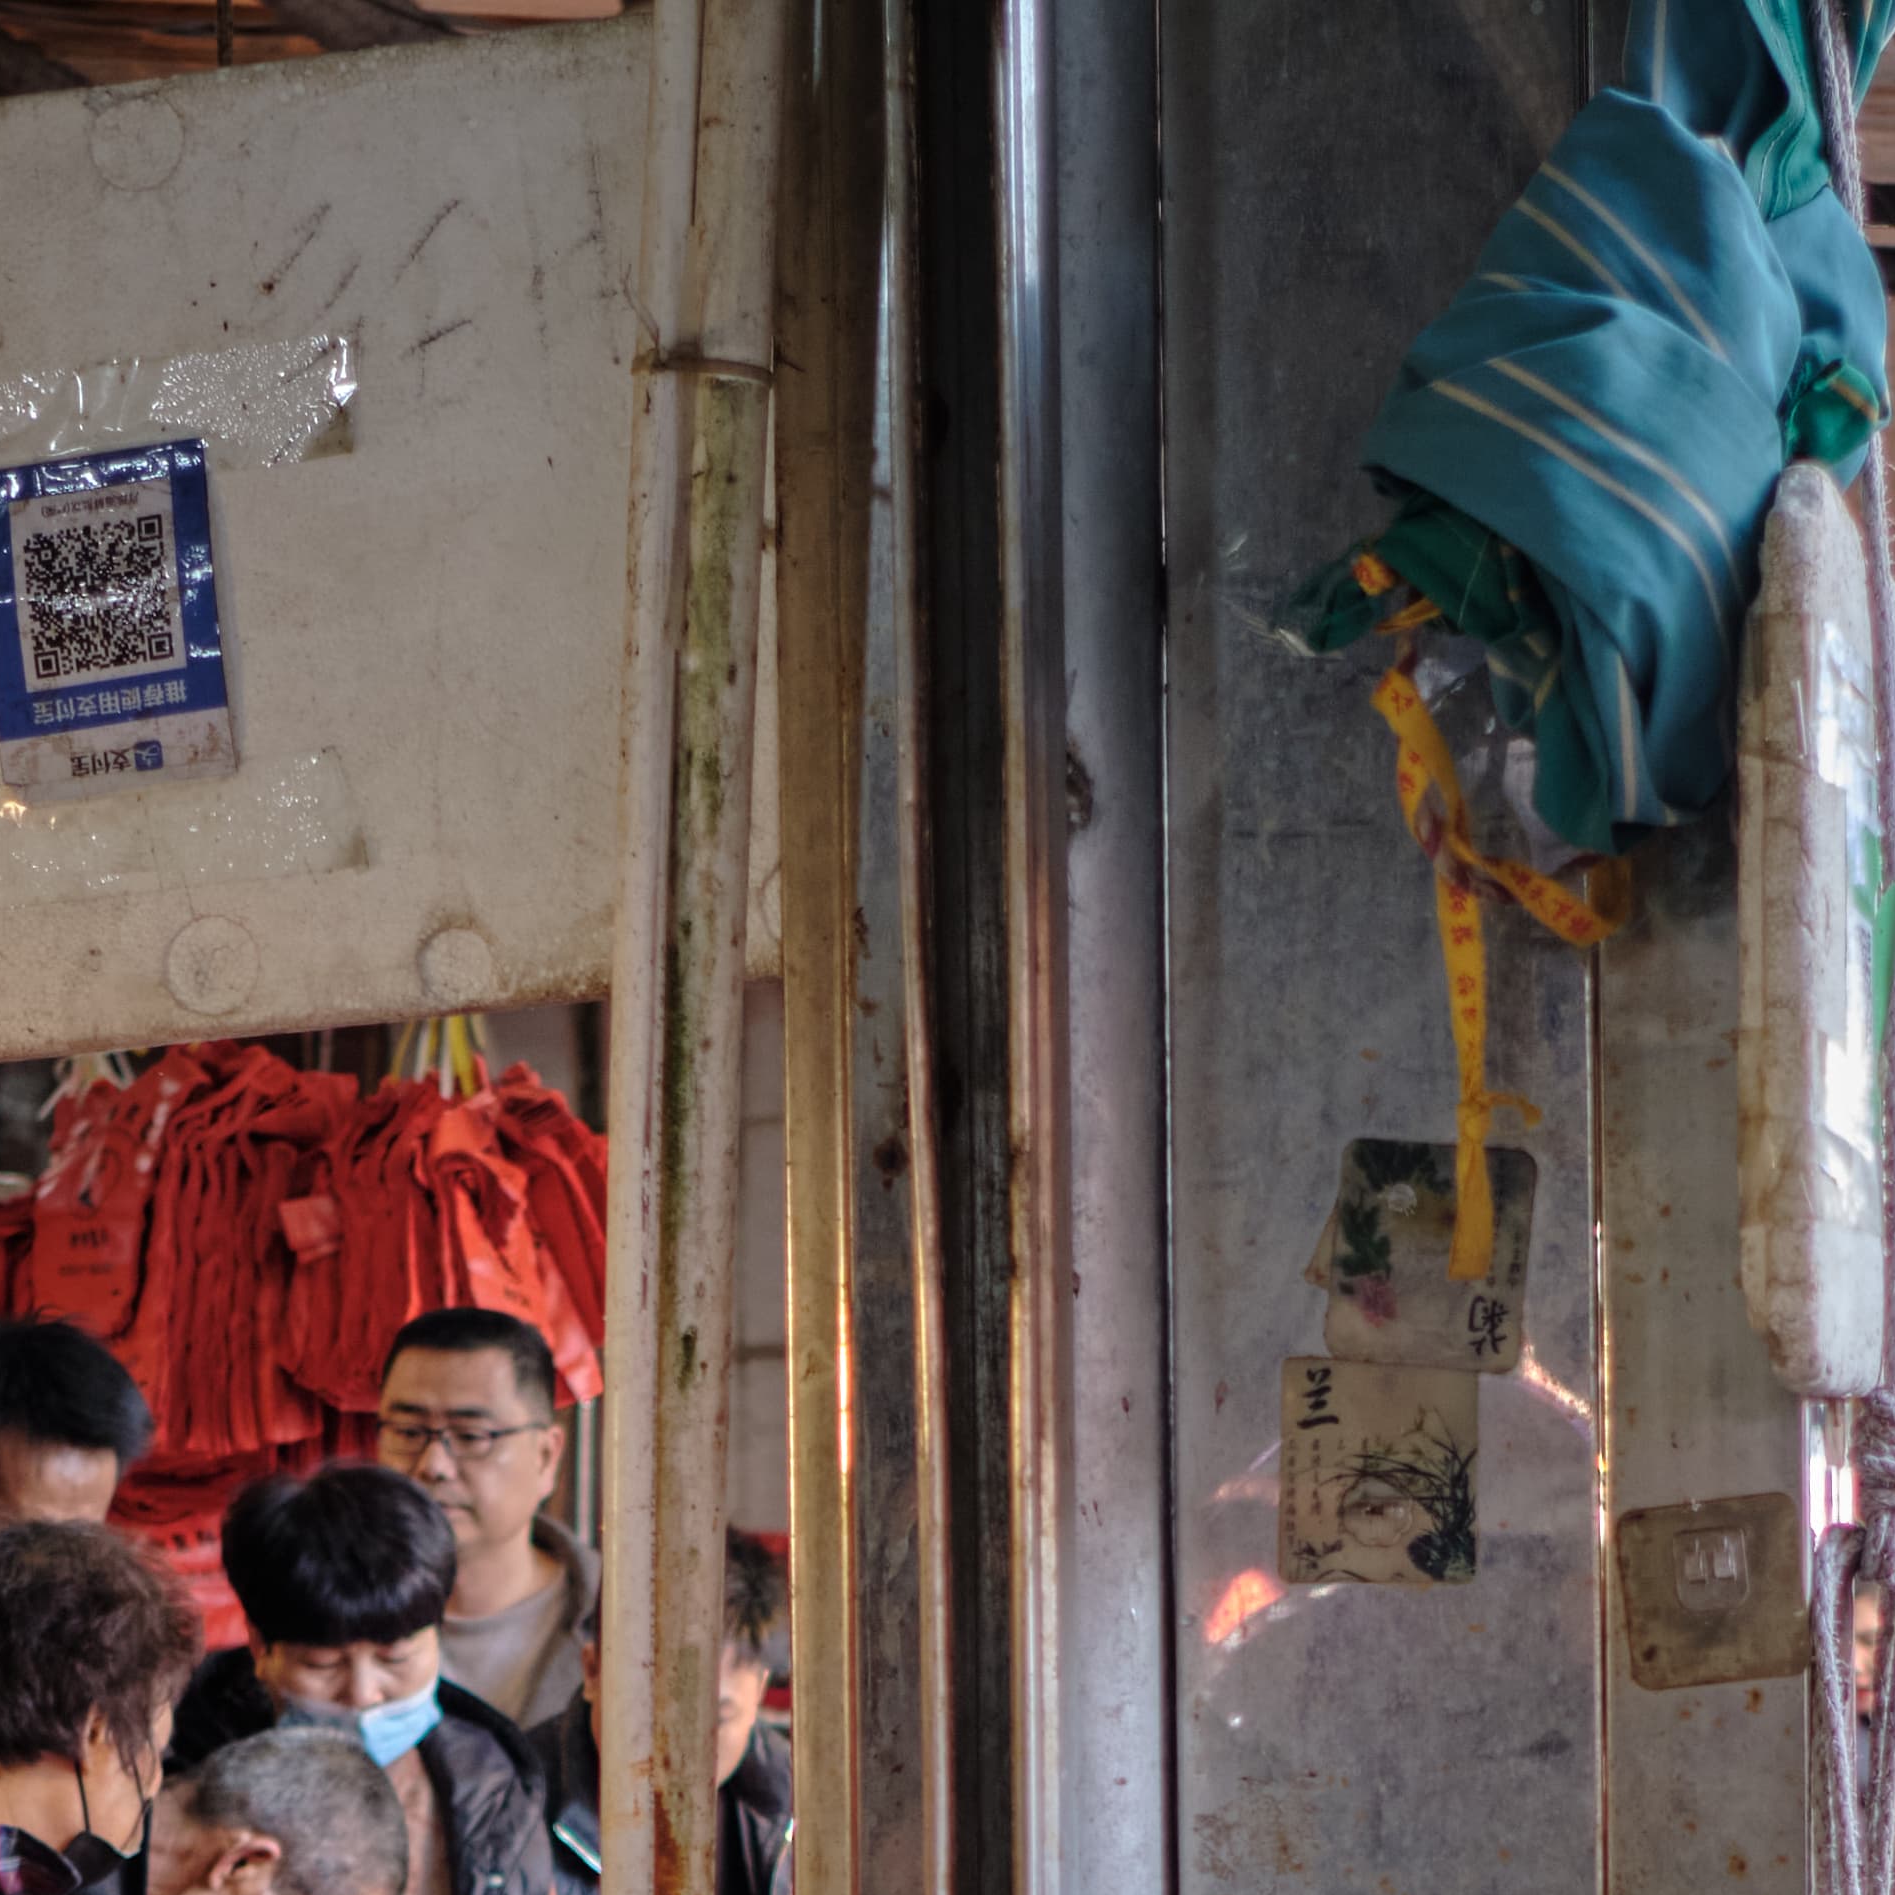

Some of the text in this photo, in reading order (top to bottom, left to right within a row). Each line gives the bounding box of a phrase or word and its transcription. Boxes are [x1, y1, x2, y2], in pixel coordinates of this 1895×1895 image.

[32, 679, 187, 725] 推荐使用支付宝
[70, 748, 131, 777] 支付宝
